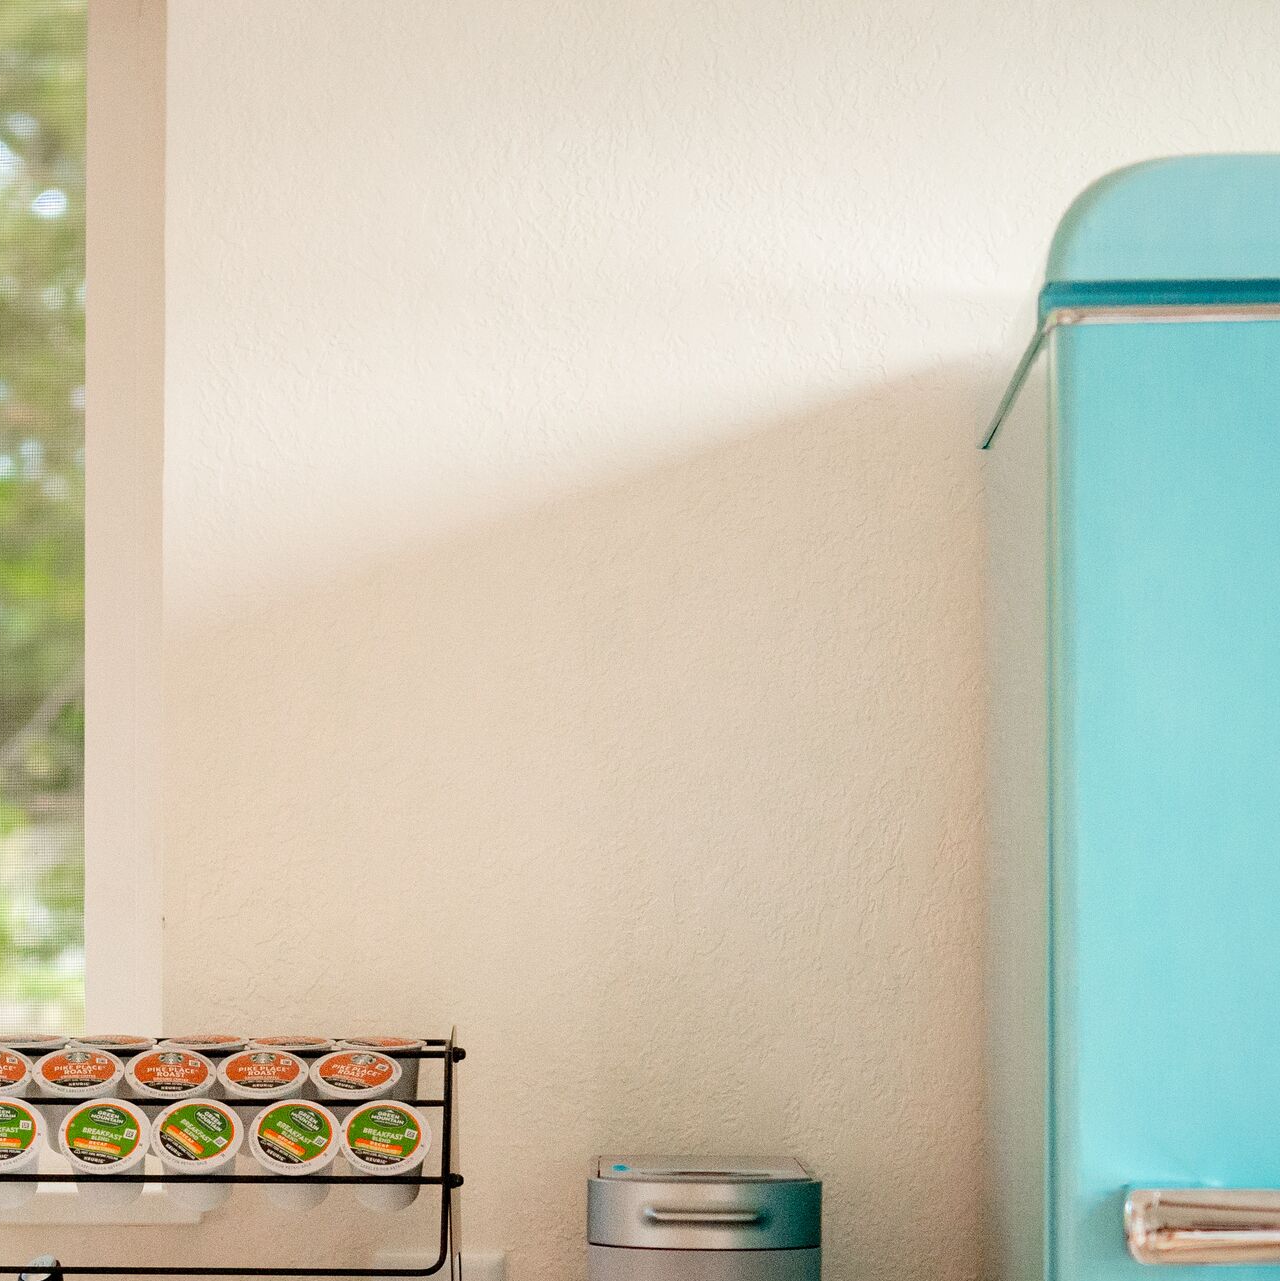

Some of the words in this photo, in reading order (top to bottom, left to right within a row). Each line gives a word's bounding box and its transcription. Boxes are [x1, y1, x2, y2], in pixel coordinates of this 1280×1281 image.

[352, 1066, 378, 1077] PLACE
[91, 1114, 124, 1124] MOUNTAIN
[196, 1112, 222, 1132] MOUNTAIN
[204, 1111, 222, 1125] GREEN
[291, 1112, 319, 1131] MOUNTAIN
[299, 1111, 318, 1124] GREEN
[371, 1115, 404, 1125] MOUNTAIN
[82, 1127, 122, 1141] BREAKFAST
[181, 1119, 211, 1143] BREAKFAST
[184, 1128, 199, 1140] BLEND
[277, 1121, 311, 1144] BREAKFAST
[281, 1130, 298, 1142] BLEND
[363, 1128, 403, 1140] BREAKFAST
